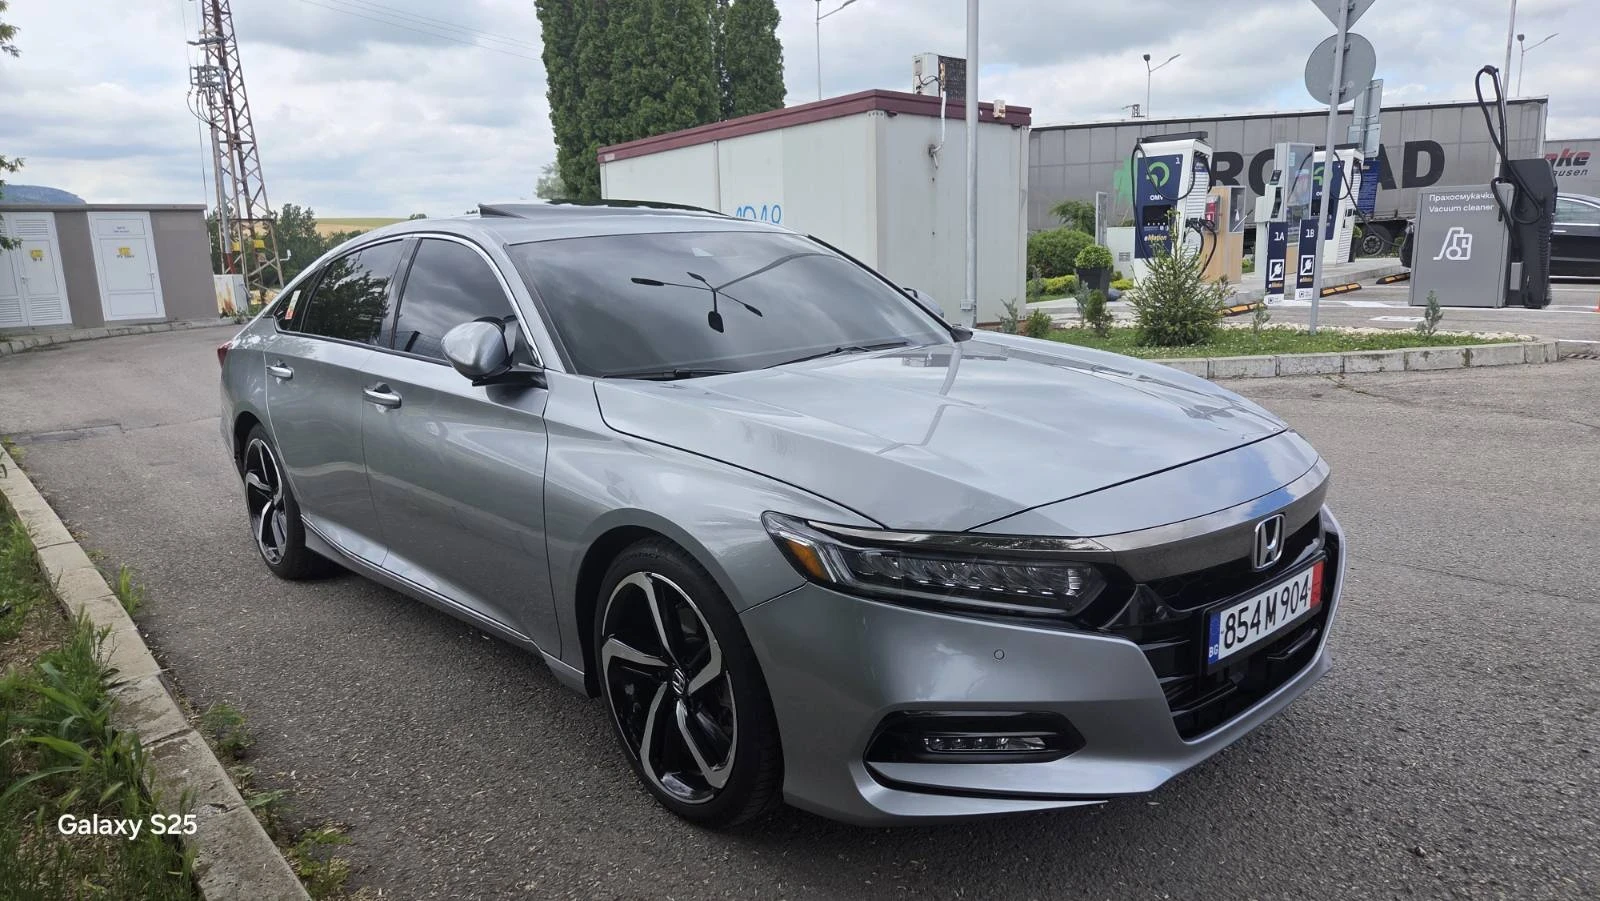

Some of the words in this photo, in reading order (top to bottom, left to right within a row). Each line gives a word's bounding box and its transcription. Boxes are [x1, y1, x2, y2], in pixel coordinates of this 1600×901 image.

[1429, 205, 1462, 213] Vacuum
[1463, 203, 1495, 211] cleaner
[1274, 231, 1285, 241] 1A
[1305, 228, 1315, 238] 1B
[1208, 644, 1219, 658] BG
